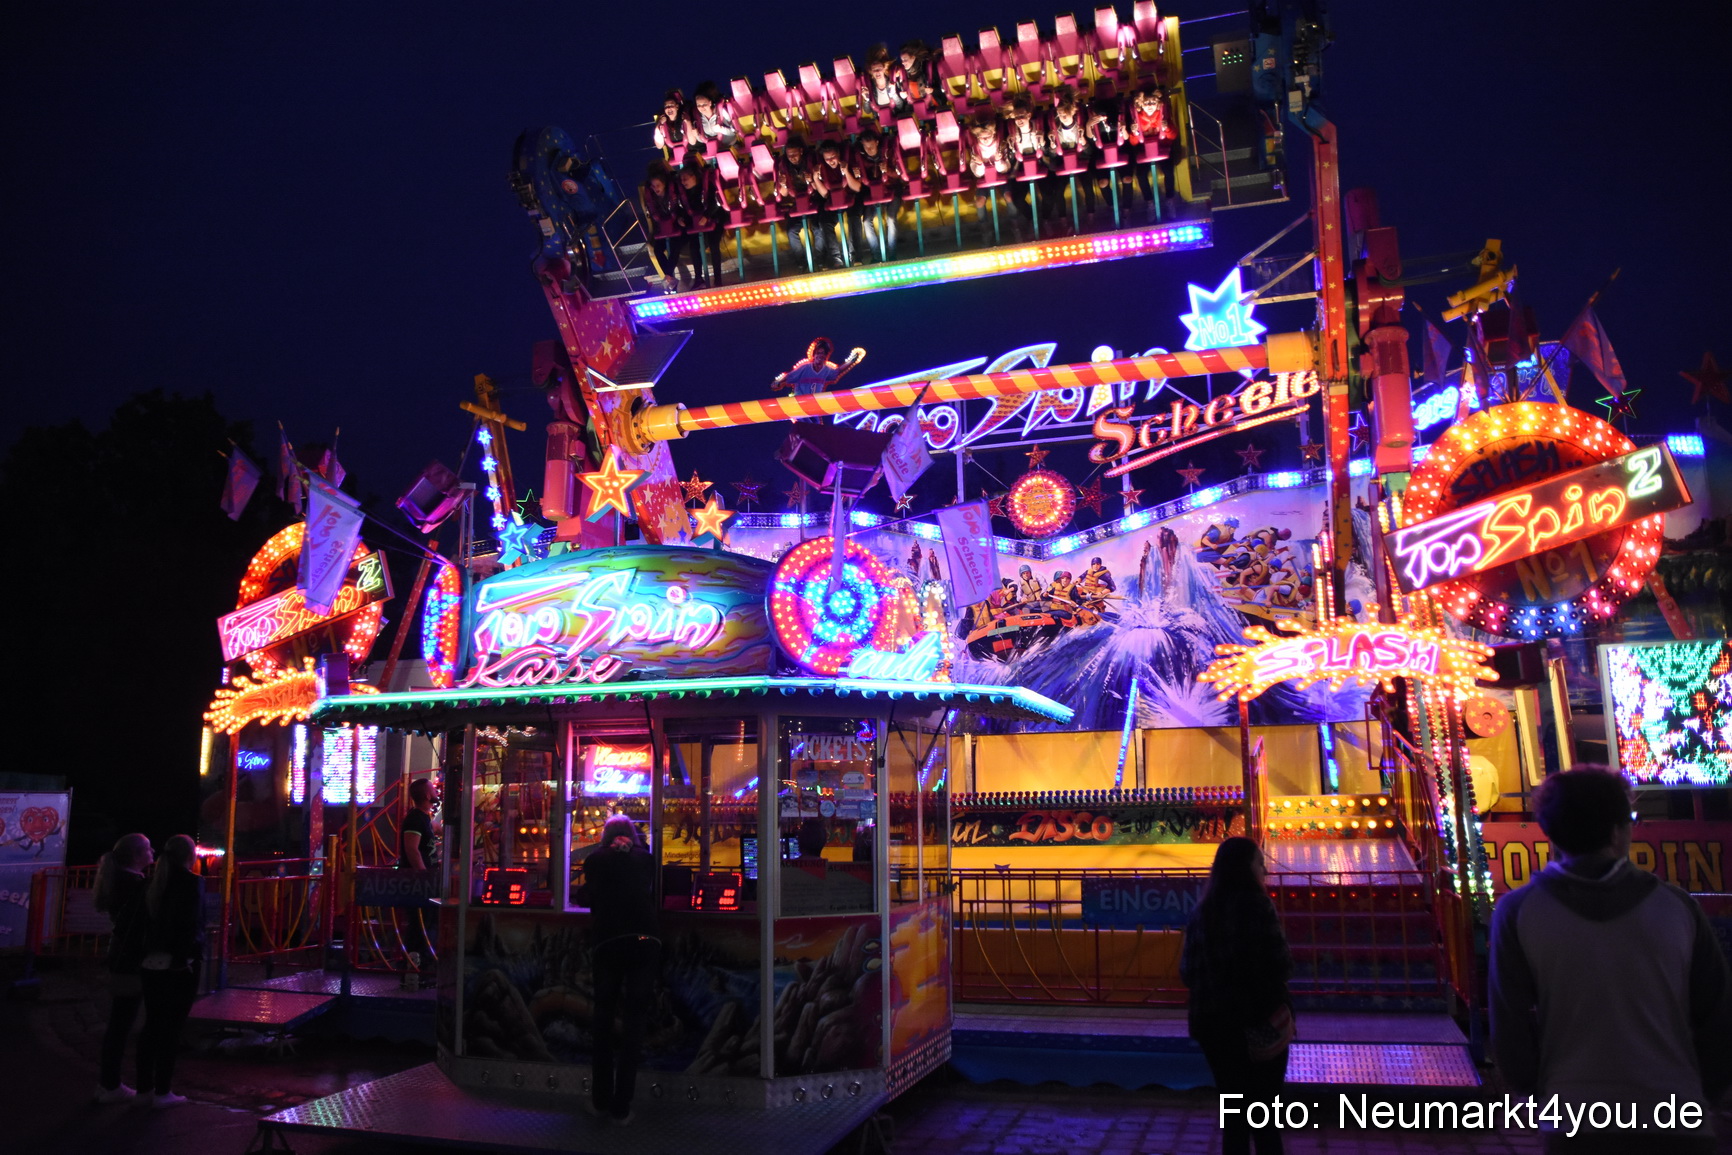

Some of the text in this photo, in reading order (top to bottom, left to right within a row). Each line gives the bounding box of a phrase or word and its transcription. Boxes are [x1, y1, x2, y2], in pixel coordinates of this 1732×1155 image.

[1088, 368, 1321, 464] Scheele
[458, 644, 623, 688] Kasse
[1250, 632, 1439, 683] SPLASH
[788, 733, 867, 761] TICKETS
[362, 875, 439, 899] AUSGAN
[1099, 884, 1202, 915] EINGAN
